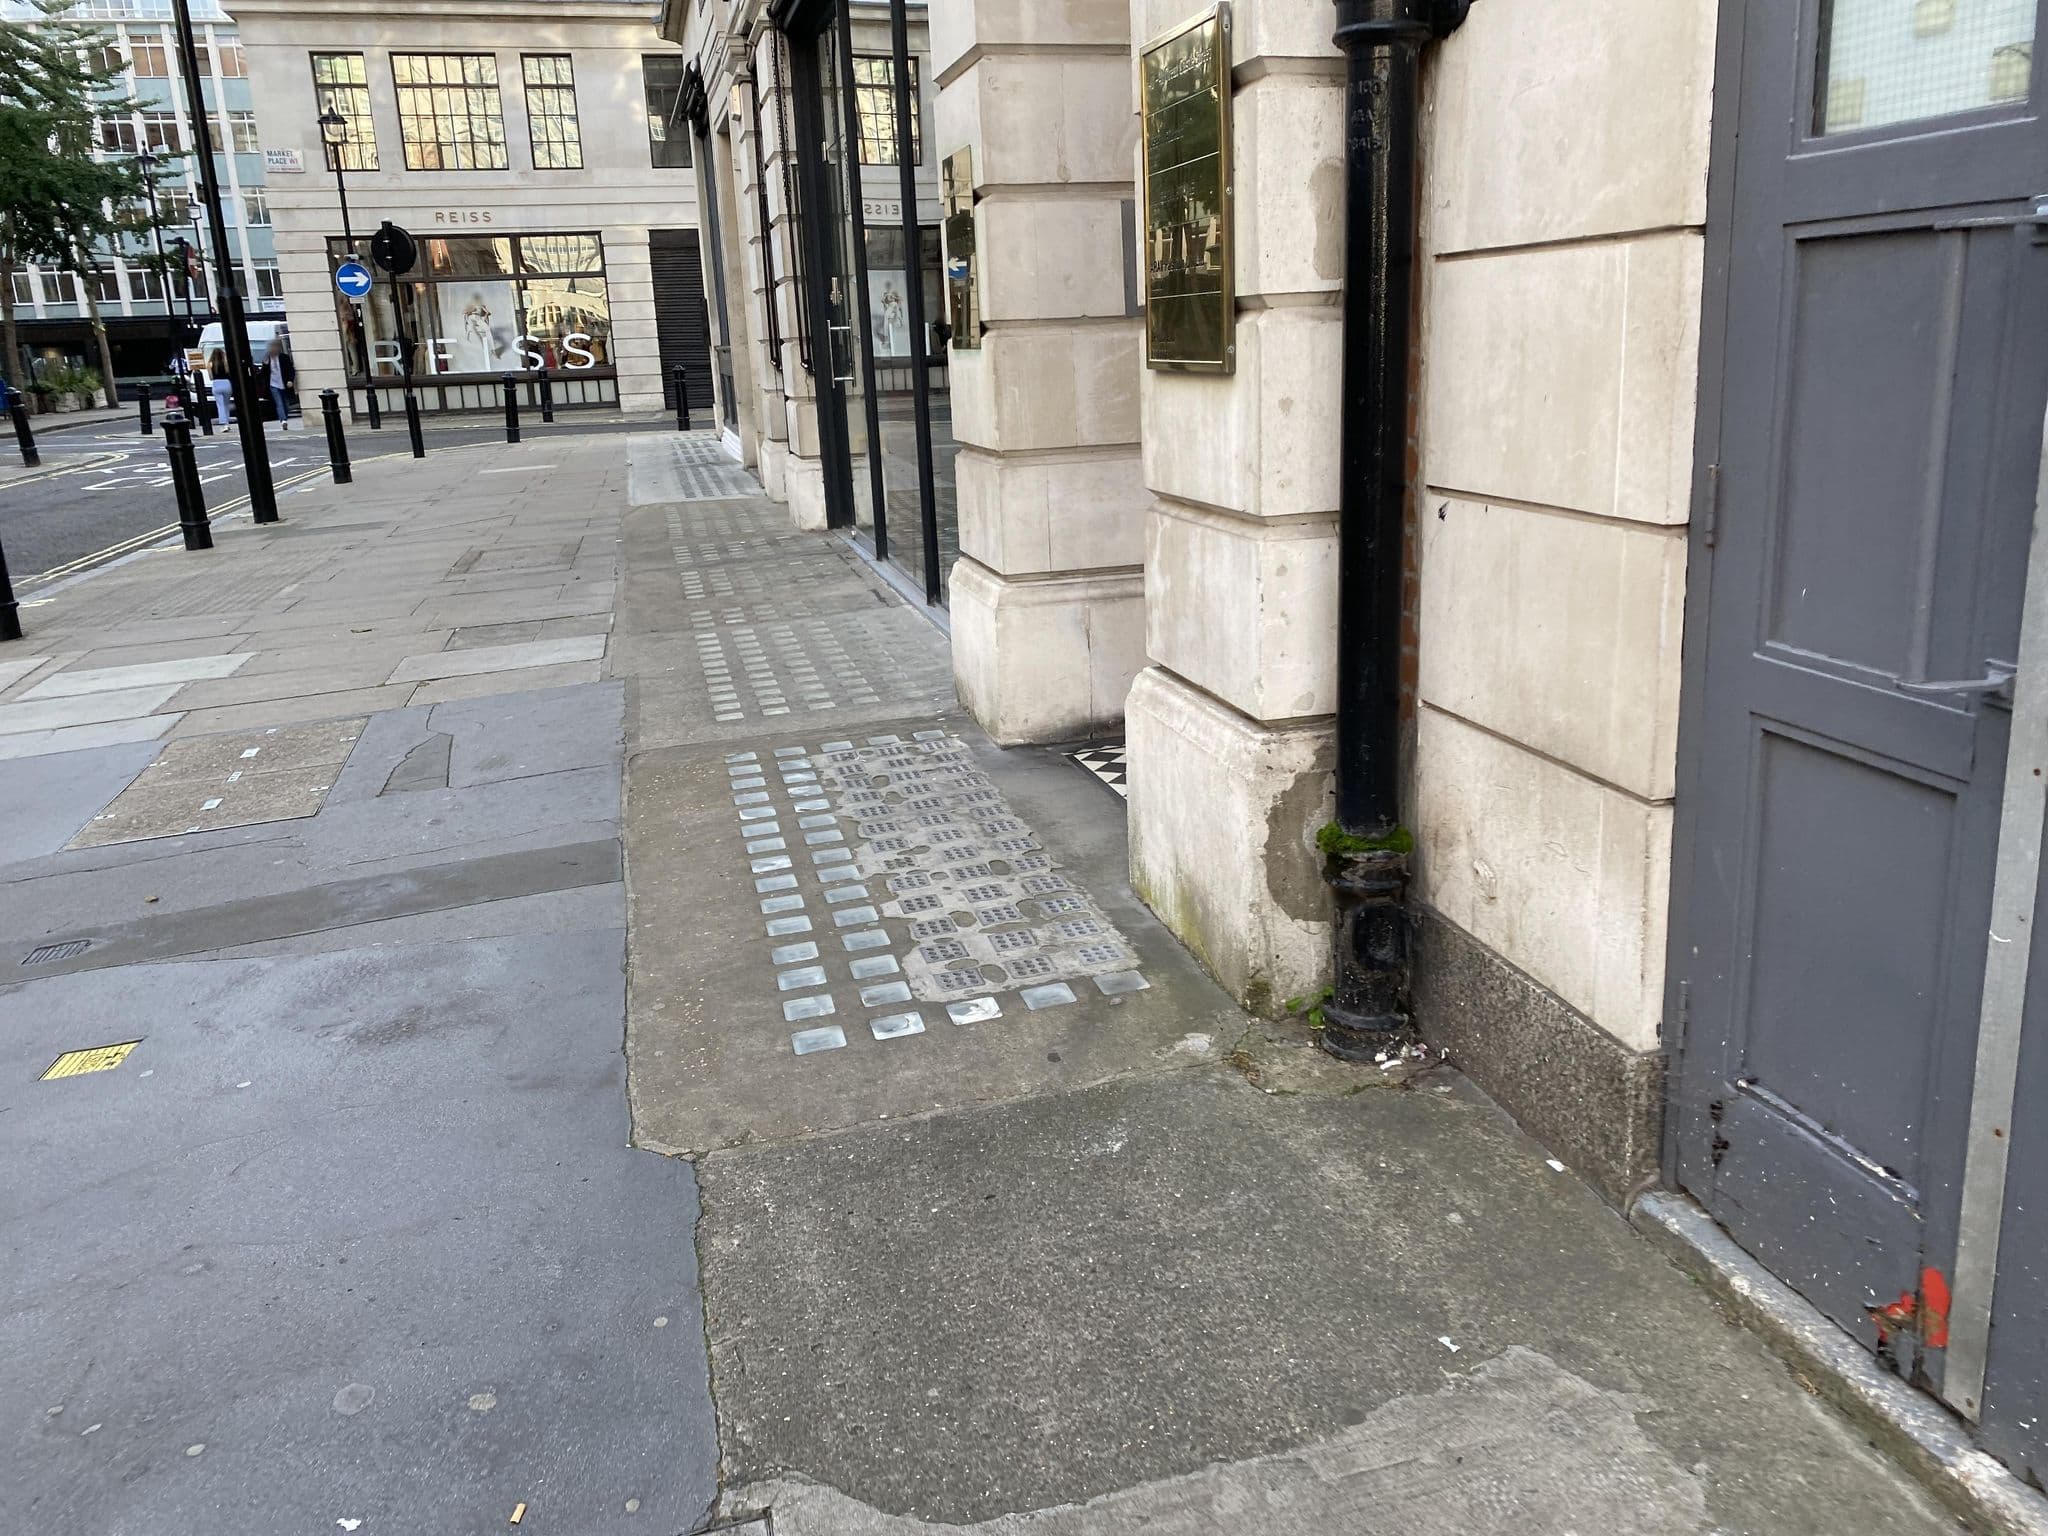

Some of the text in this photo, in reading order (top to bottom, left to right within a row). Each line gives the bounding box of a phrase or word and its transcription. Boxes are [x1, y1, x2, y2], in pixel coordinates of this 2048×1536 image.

[266, 150, 293, 158] MARKET
[267, 157, 288, 165] PLACE
[435, 211, 492, 223] REISS
[370, 333, 595, 376] REISS
